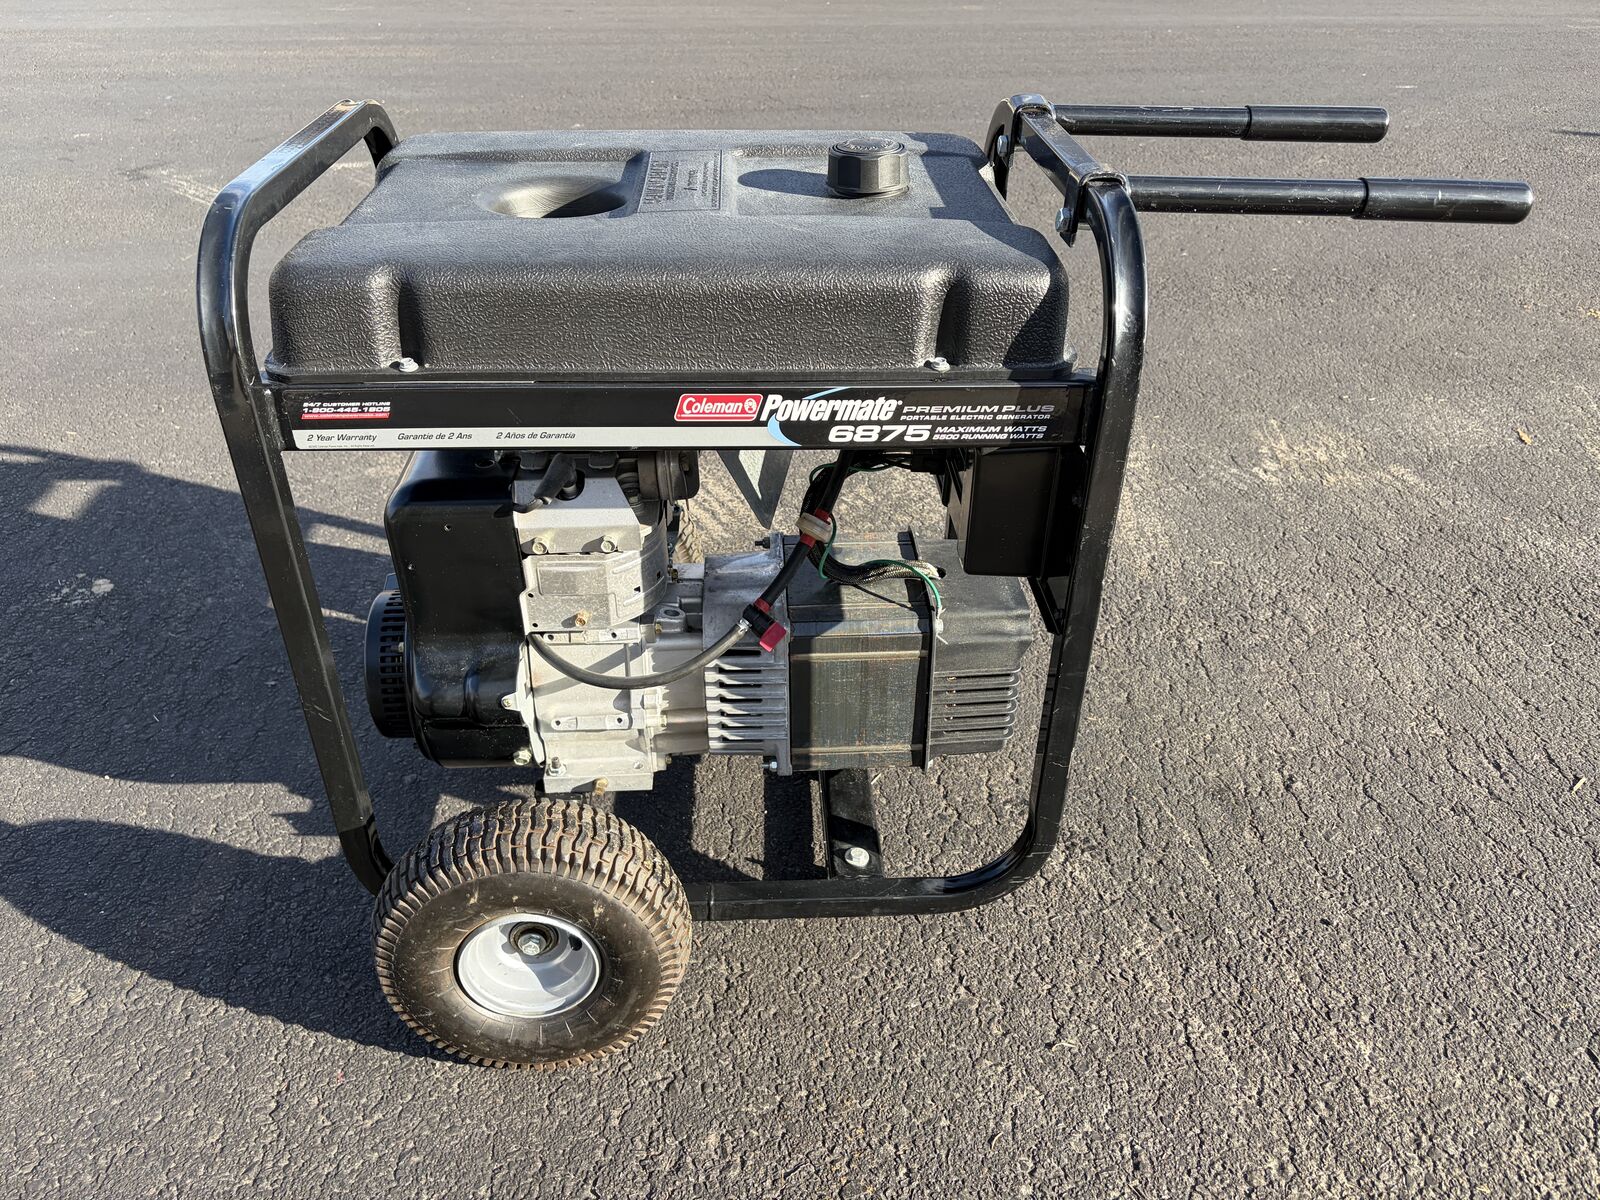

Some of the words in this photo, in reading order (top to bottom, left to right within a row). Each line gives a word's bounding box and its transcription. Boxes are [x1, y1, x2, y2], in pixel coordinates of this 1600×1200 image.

[683, 397, 743, 414] Coleman
[902, 405, 1000, 413] PREMIUM
[1001, 404, 1055, 413] PLUS
[337, 433, 378, 442] Warranty
[435, 432, 446, 440] de
[447, 432, 454, 440] 2
[456, 432, 473, 440] Ans
[496, 432, 503, 440] 2
[503, 431, 526, 440] Años
[527, 432, 538, 440] de
[828, 424, 932, 442] 6875
